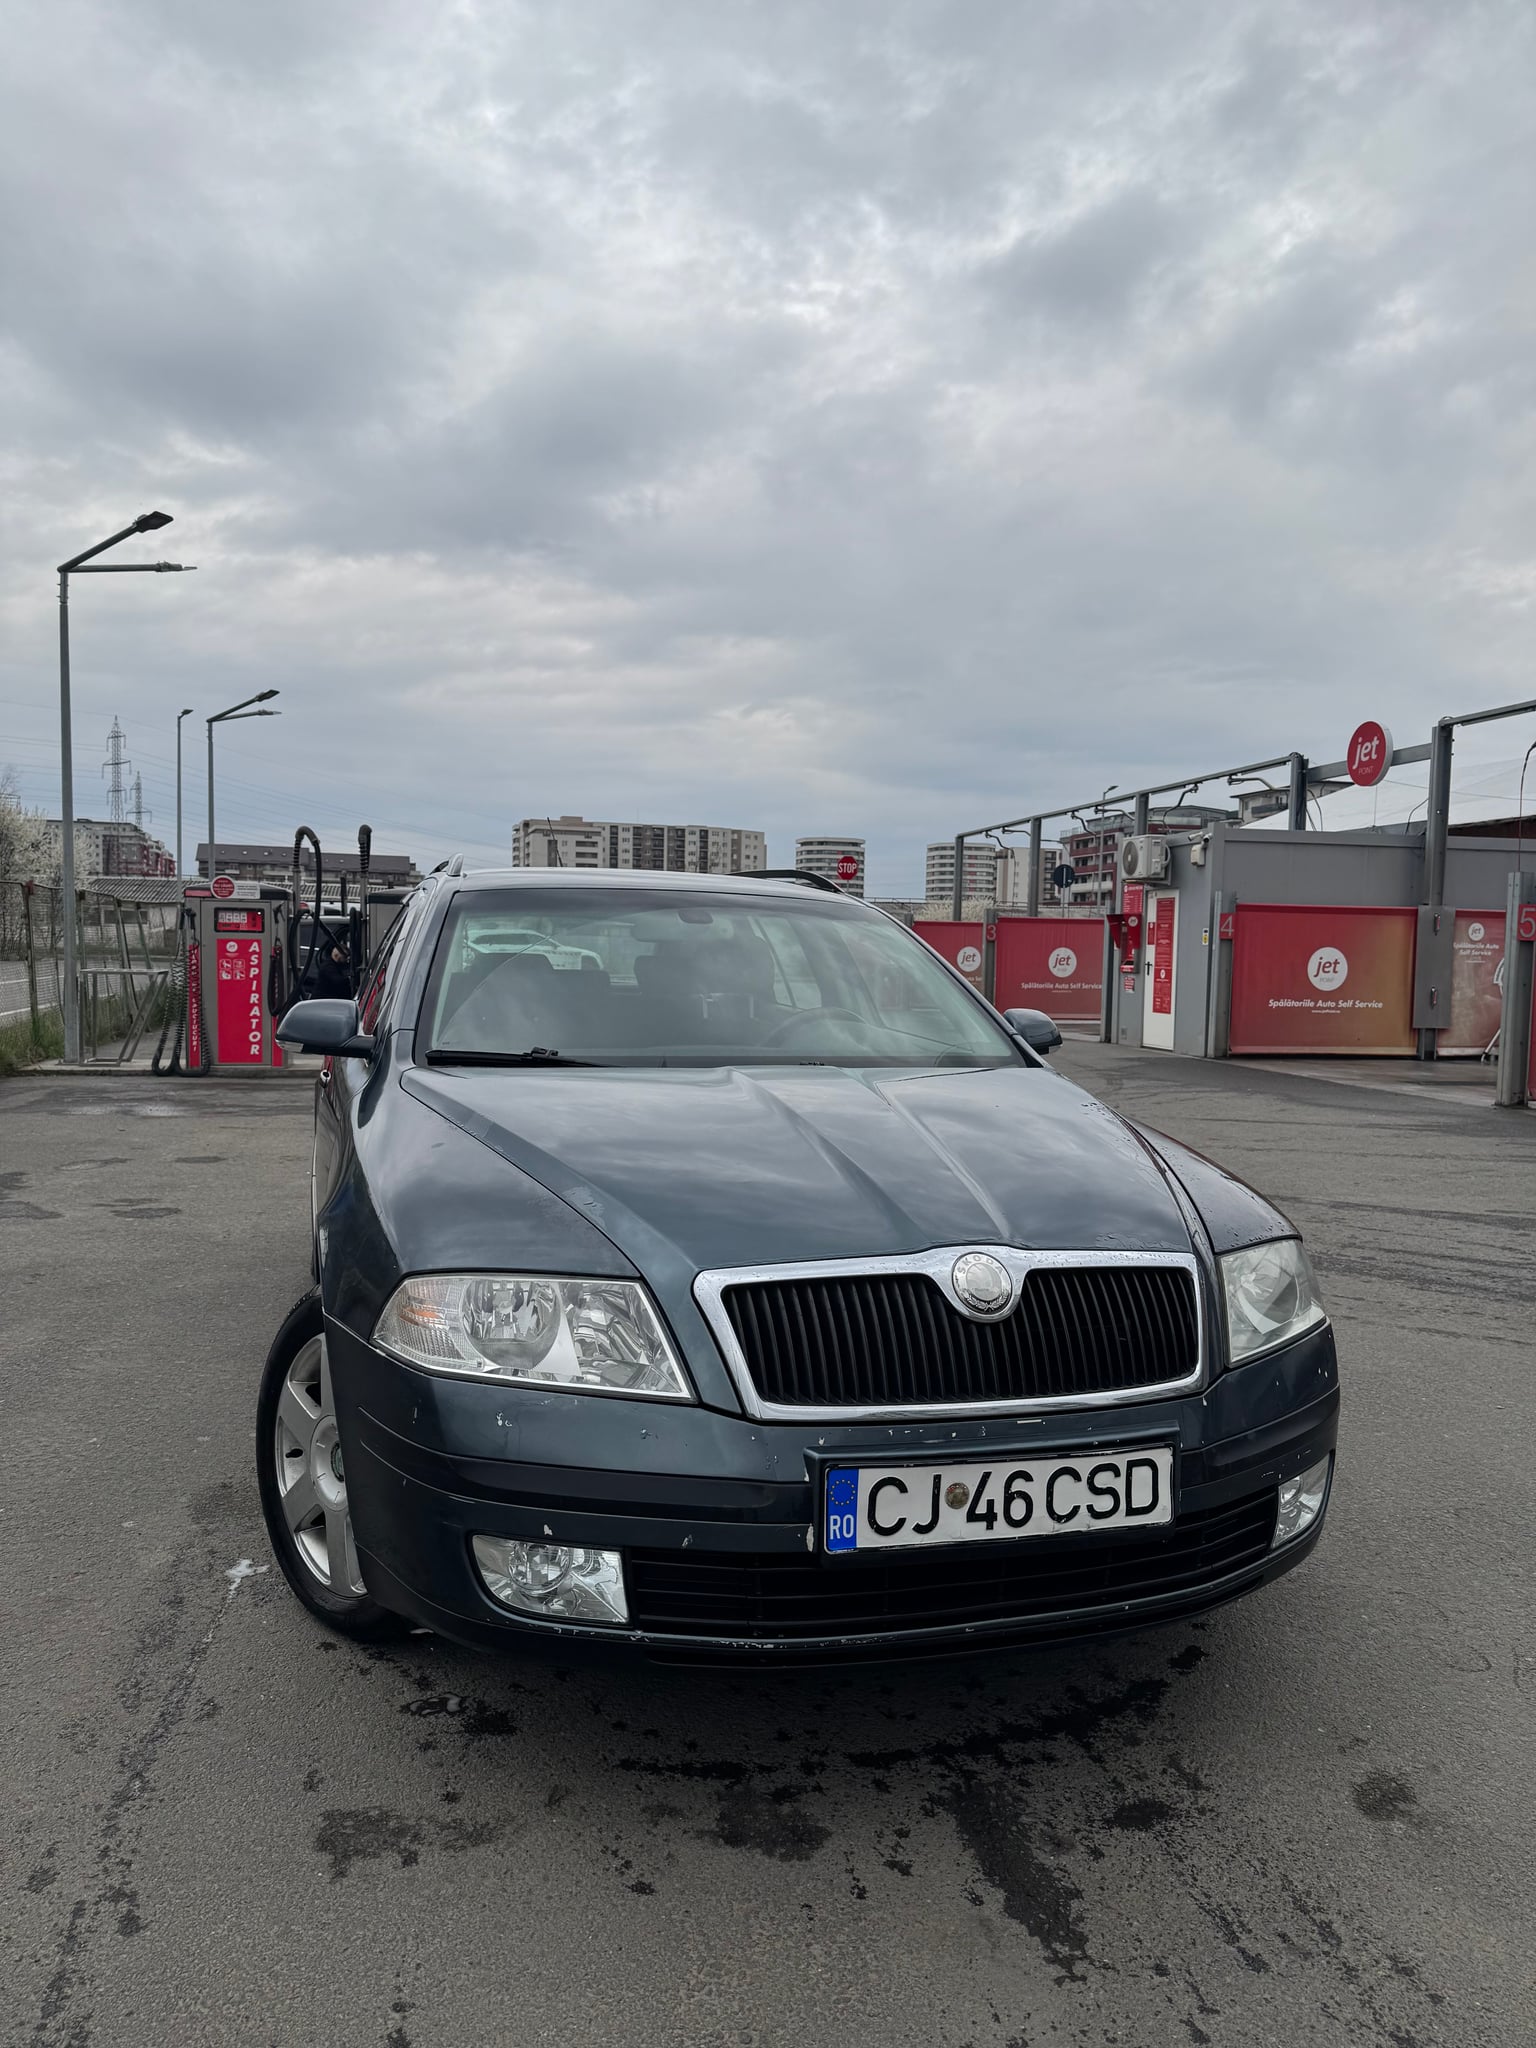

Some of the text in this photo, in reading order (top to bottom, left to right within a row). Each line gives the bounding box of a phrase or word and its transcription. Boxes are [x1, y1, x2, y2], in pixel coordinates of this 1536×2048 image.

[1352, 735, 1380, 770] jet
[1358, 766, 1374, 775] POINT
[838, 863, 857, 873] STOP
[1220, 917, 1235, 937] 4
[1519, 907, 1536, 938] 5
[987, 924, 996, 941] 3
[1471, 927, 1482, 936] jet
[961, 951, 976, 964] jet
[1053, 953, 1072, 968] jet
[1314, 956, 1340, 978] jet
[1070, 982, 1081, 990] Self
[248, 941, 261, 1055] ASPIRATOR
[1268, 998, 1384, 1009] Spălătoriile Auto Self Service
[866, 1456, 1160, 1538] CJ 46 CSD
[829, 1513, 856, 1541] RO
